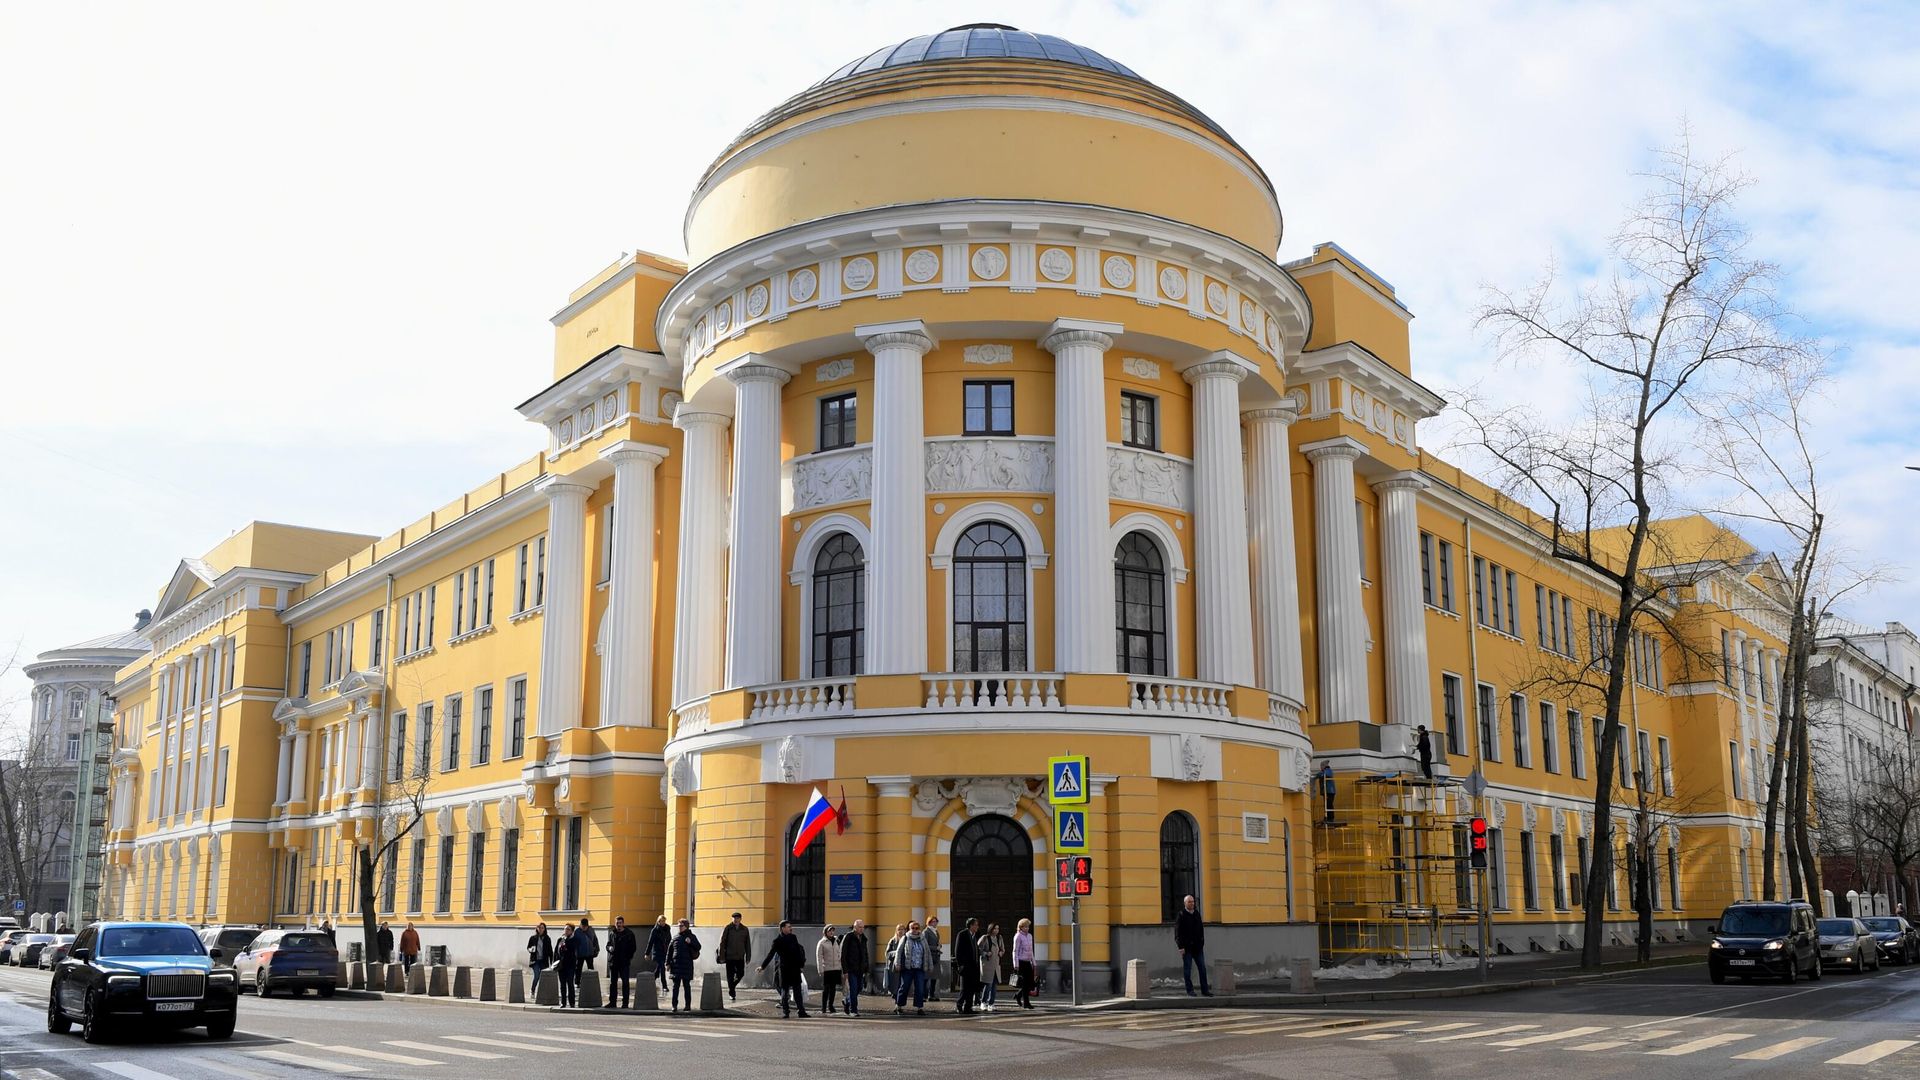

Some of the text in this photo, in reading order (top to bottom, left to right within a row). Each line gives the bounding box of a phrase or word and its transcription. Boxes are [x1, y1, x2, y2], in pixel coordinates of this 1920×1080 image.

[1473, 837, 1487, 849] 30
[1076, 880, 1089, 893] 06
[17, 901, 24, 909] P
